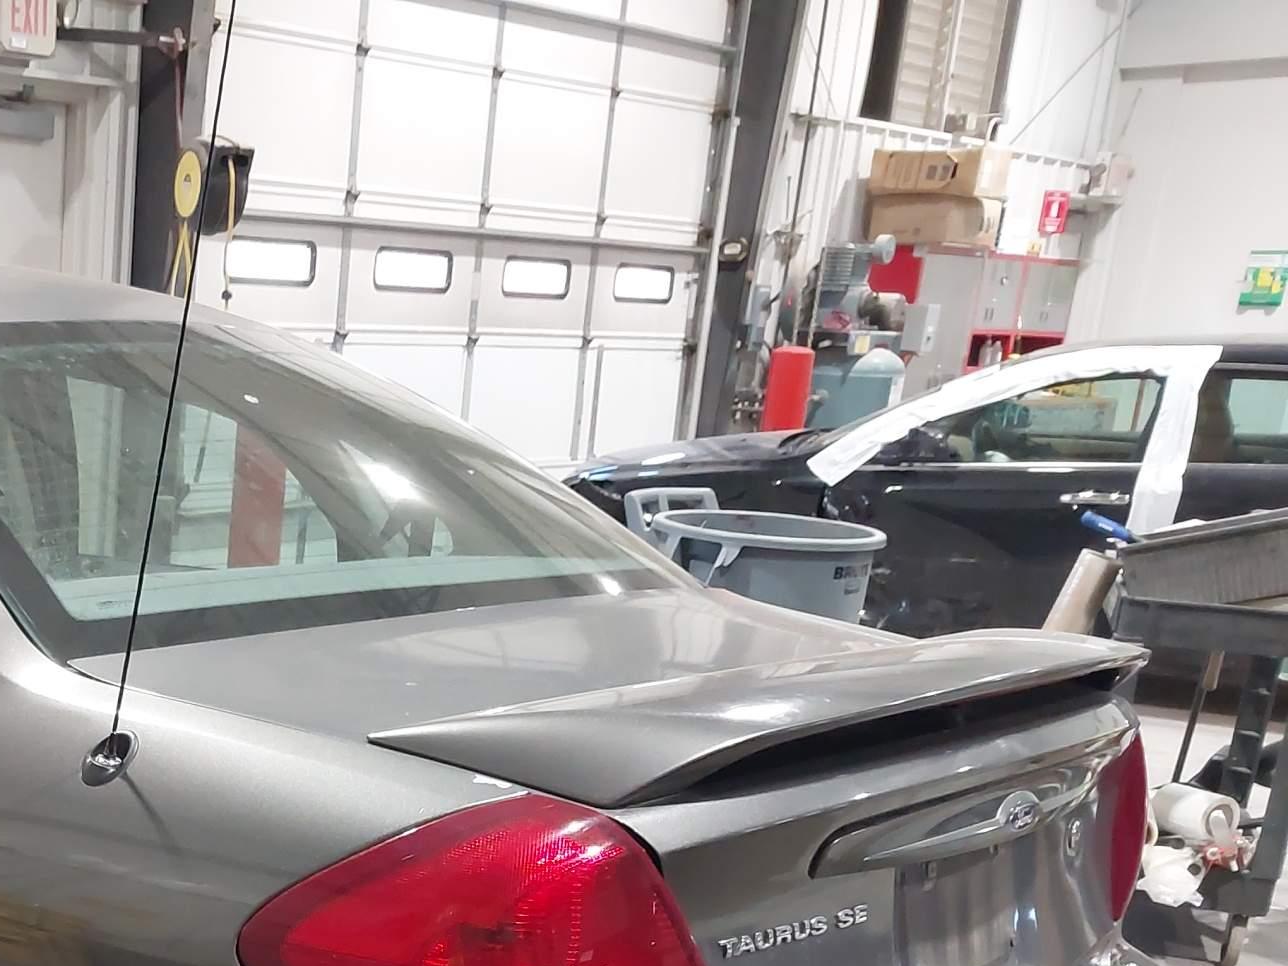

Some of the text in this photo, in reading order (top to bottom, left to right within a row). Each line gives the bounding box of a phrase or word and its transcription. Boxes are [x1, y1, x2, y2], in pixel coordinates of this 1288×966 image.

[11, 0, 48, 36] EXIT
[718, 904, 868, 959] TAURUS SE
